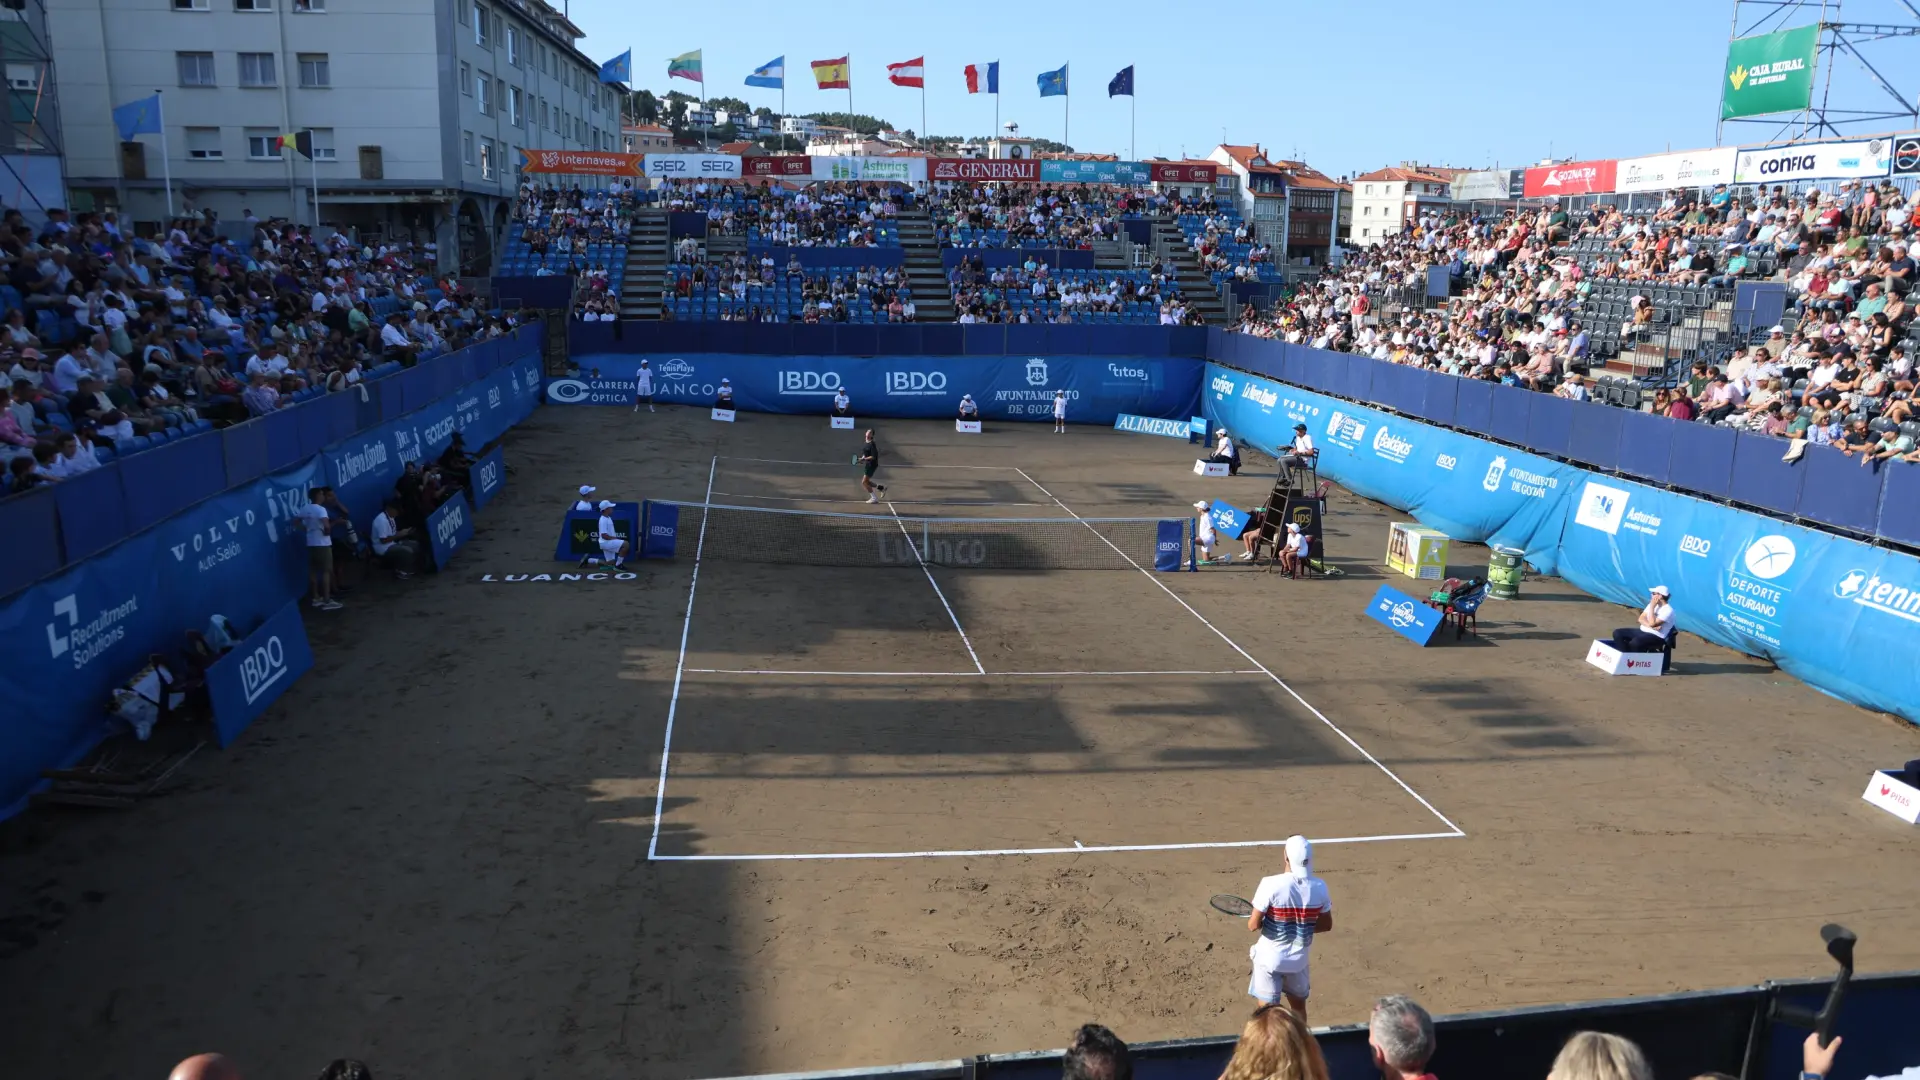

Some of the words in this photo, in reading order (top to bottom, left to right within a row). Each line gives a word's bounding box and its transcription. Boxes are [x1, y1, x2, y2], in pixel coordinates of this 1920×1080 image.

[1771, 58, 1804, 74] RURAL
[653, 160, 686, 172] SER
[702, 160, 734, 172] SER
[863, 159, 908, 171] Asturias
[959, 162, 1034, 178] GENERALI
[786, 371, 841, 389] BDO
[893, 371, 947, 389] BDO
[1113, 366, 1144, 378] titos
[591, 381, 636, 390] CARRERA
[650, 383, 714, 396] UANCO
[591, 393, 628, 402] ÓPTICA
[995, 390, 1079, 401] AYUNTAMIETO
[1008, 404, 1023, 414] DE
[1118, 416, 1190, 438] ALIMERKA
[1439, 453, 1457, 468] BDO
[335, 458, 347, 487] La
[344, 452, 366, 482] Nueva
[1626, 507, 1661, 527] Asturias
[171, 509, 255, 562] VOLVO
[653, 526, 674, 534] BDO
[216, 540, 242, 562] Salón
[1161, 542, 1180, 551] BDO
[1684, 535, 1711, 554] BDO
[481, 572, 638, 583] LUANCO
[1730, 577, 1782, 603] DEPORTE
[1863, 576, 1920, 614] tenn
[1726, 592, 1776, 617] ASTURIANO
[70, 595, 138, 649] Recruitment
[73, 625, 125, 670] Solutions
[245, 634, 284, 689] BDO
[1890, 791, 1911, 807] PITAS
